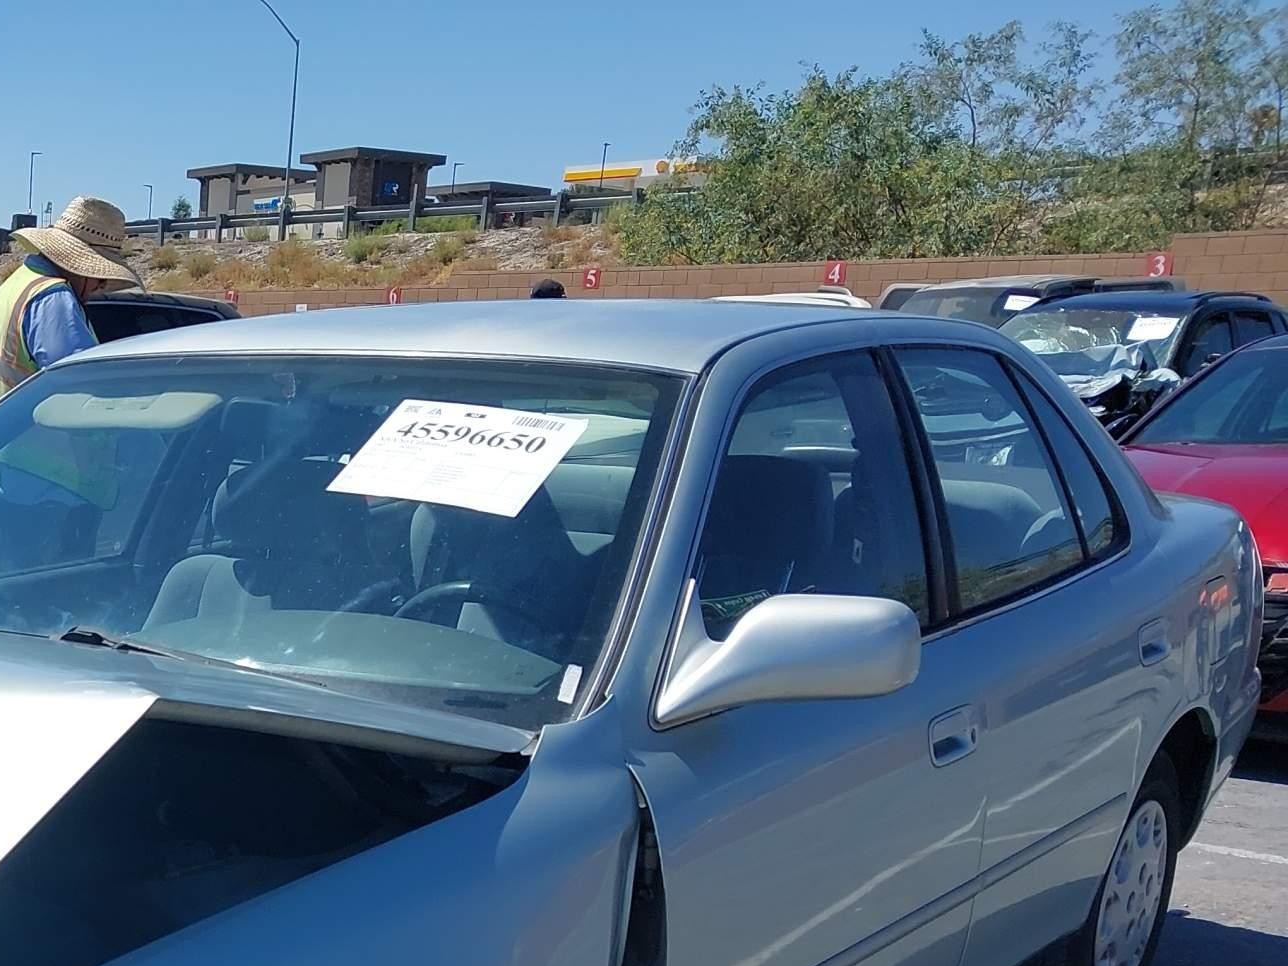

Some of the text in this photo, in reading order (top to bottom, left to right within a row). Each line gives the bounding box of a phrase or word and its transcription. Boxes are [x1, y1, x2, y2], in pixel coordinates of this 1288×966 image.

[828, 263, 841, 283] 4
[1149, 255, 1166, 277] 3
[586, 269, 597, 288] 5
[227, 290, 235, 304] 7
[388, 286, 398, 304] 6
[396, 420, 547, 454] 45596650
